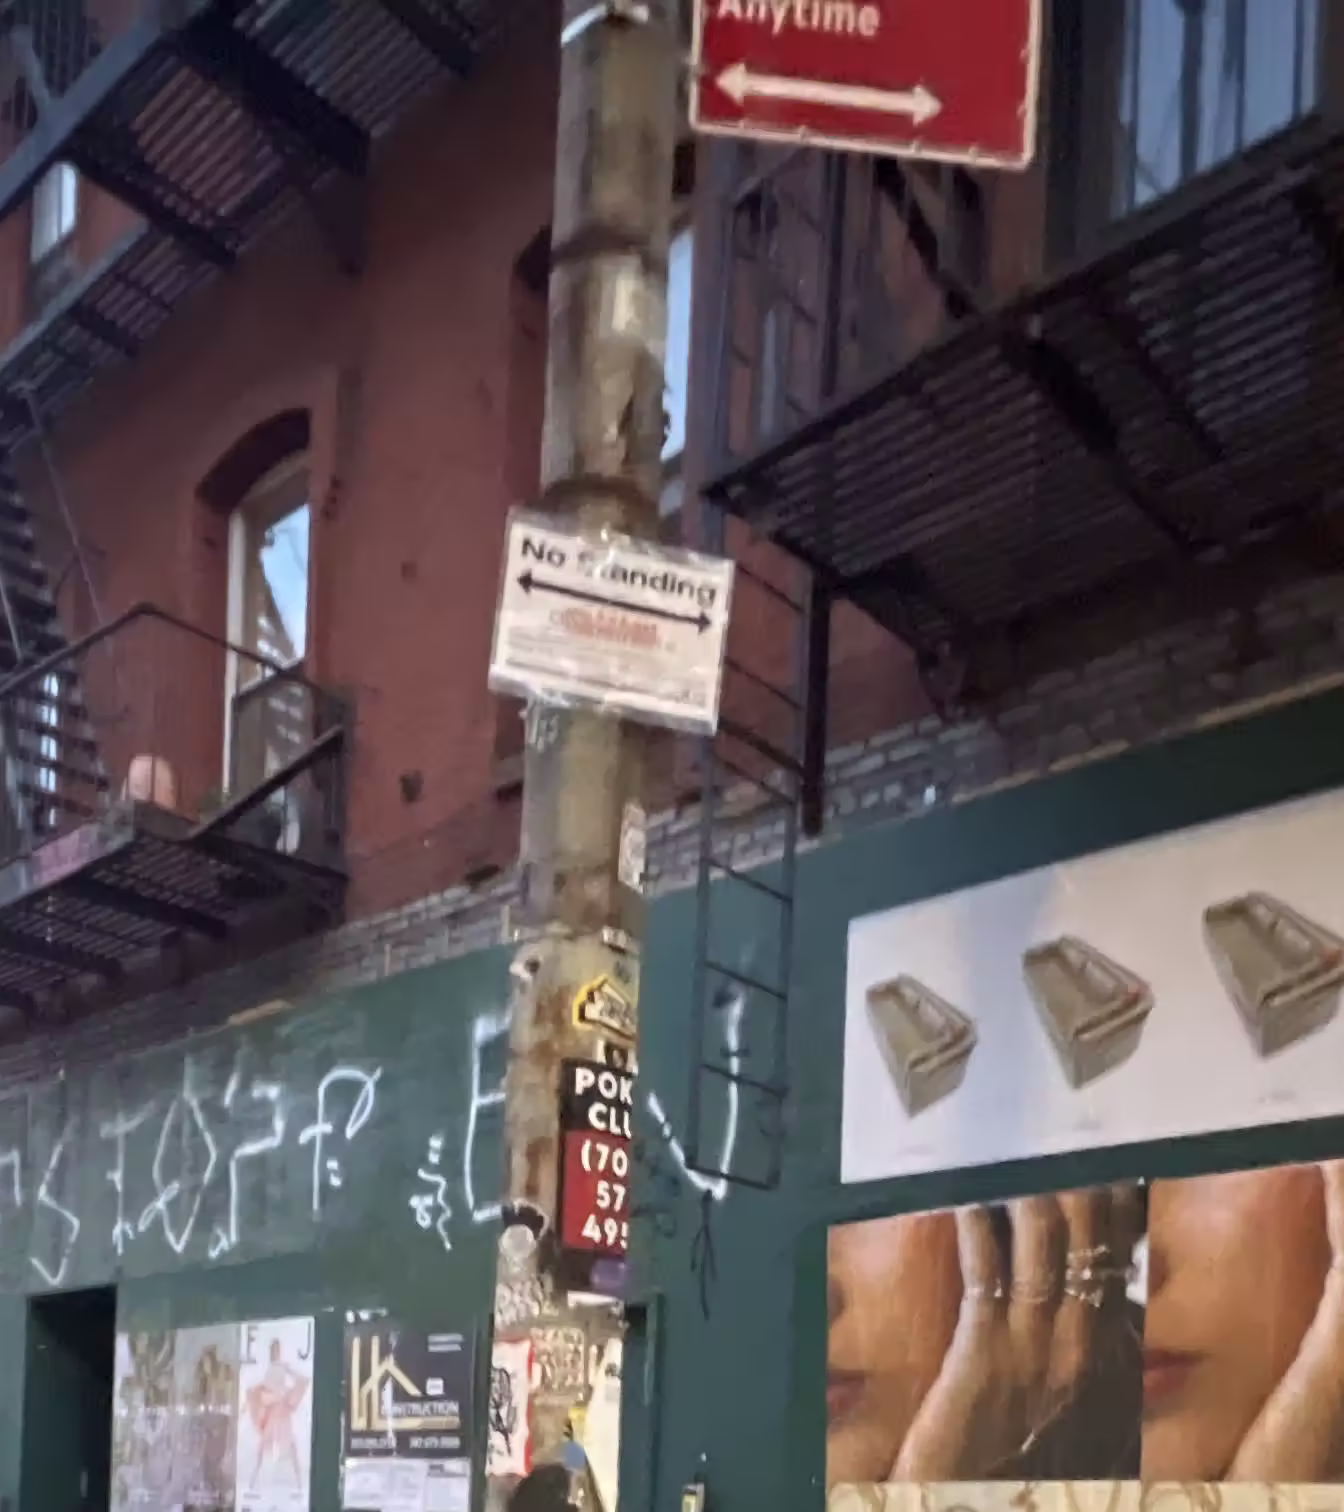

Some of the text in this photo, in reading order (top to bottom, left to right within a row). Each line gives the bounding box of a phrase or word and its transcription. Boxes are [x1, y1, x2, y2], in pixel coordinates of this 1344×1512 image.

[717, 0, 881, 36] Anytime
[520, 537, 718, 608] No Sanding
